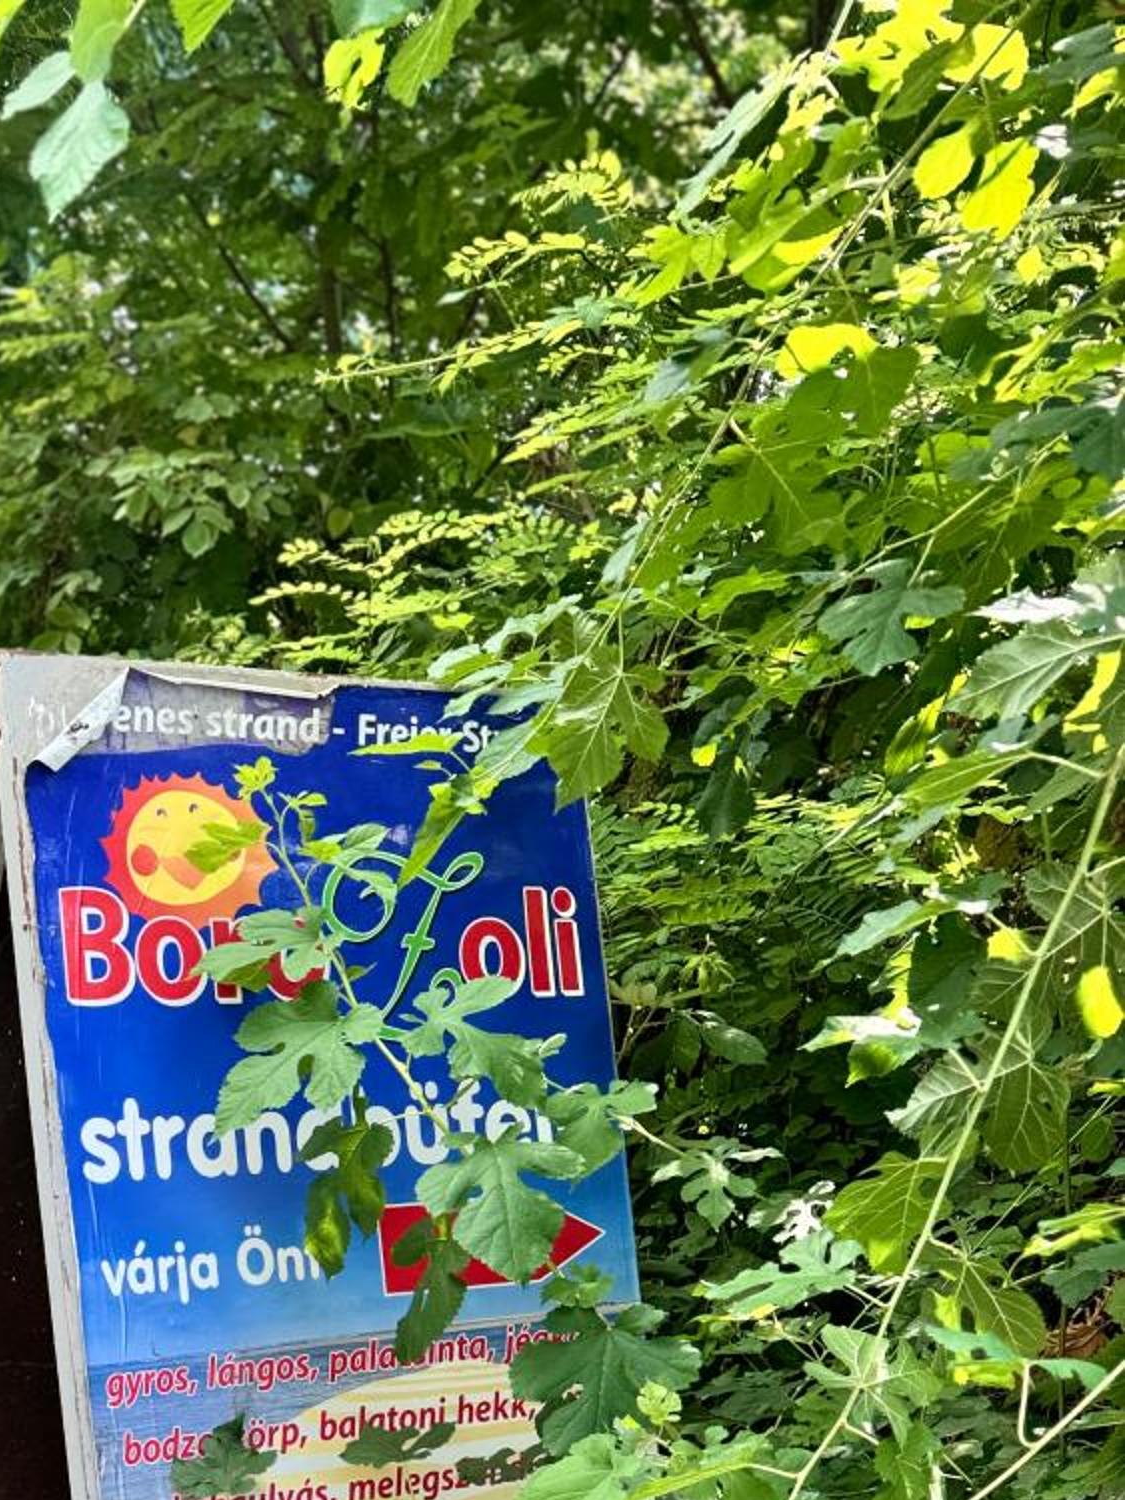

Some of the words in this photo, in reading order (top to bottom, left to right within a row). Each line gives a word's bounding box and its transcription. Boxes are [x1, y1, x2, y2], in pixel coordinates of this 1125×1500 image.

[205, 706, 321, 744] strand
[100, 1239, 219, 1305] várja
[107, 1366, 197, 1407] gyros,
[208, 1354, 319, 1391] lángos,
